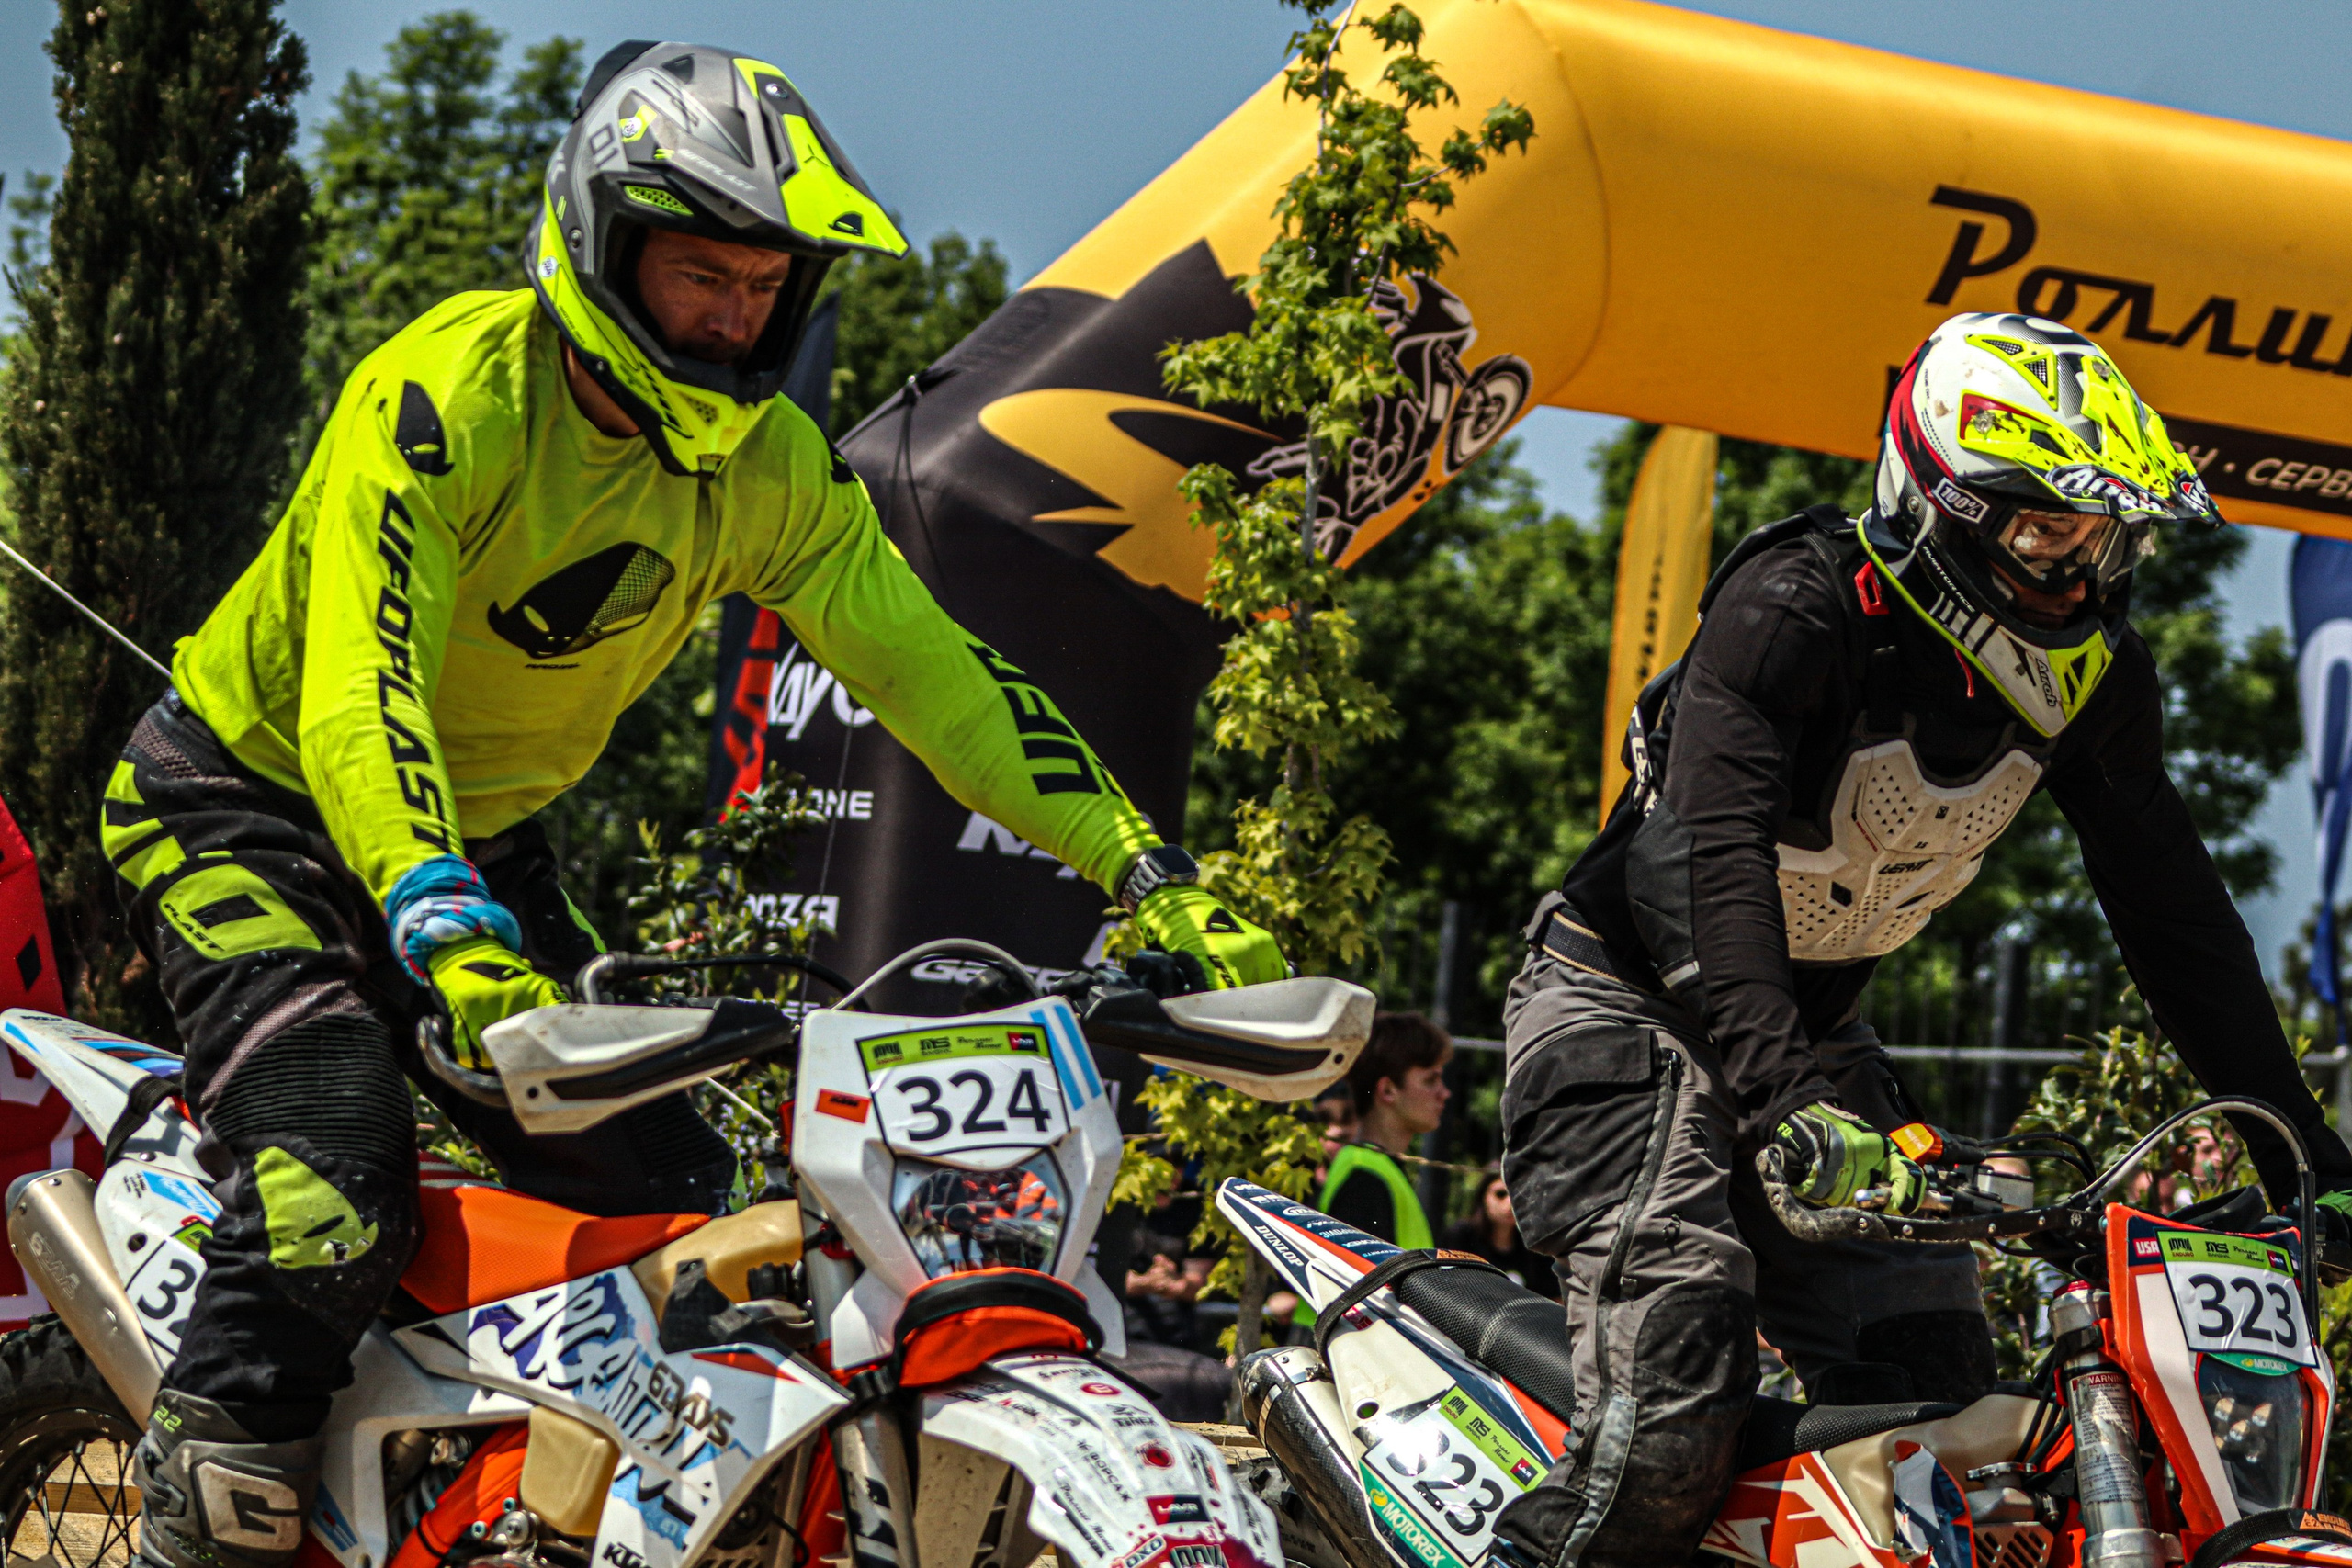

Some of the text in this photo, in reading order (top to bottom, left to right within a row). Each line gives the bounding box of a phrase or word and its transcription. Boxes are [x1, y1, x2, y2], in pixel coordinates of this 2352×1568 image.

[1939, 485, 1979, 516] 100%
[2245, 458, 2352, 500] СЕРВ
[1922, 546, 1958, 592] AVIATOR
[1955, 592, 1975, 613] ACE
[2035, 657, 2058, 707] Airoh
[164, 902, 225, 952] PLAST
[895, 1068, 1052, 1142] 324
[1254, 1224, 1306, 1268] DUNLOP
[2136, 1239, 2159, 1255] USA
[2188, 1273, 2297, 1348] 323
[2253, 1358, 2289, 1372] MOTOREX
[153, 1405, 182, 1430] 22
[1381, 1501, 1447, 1567] MOTOREX
